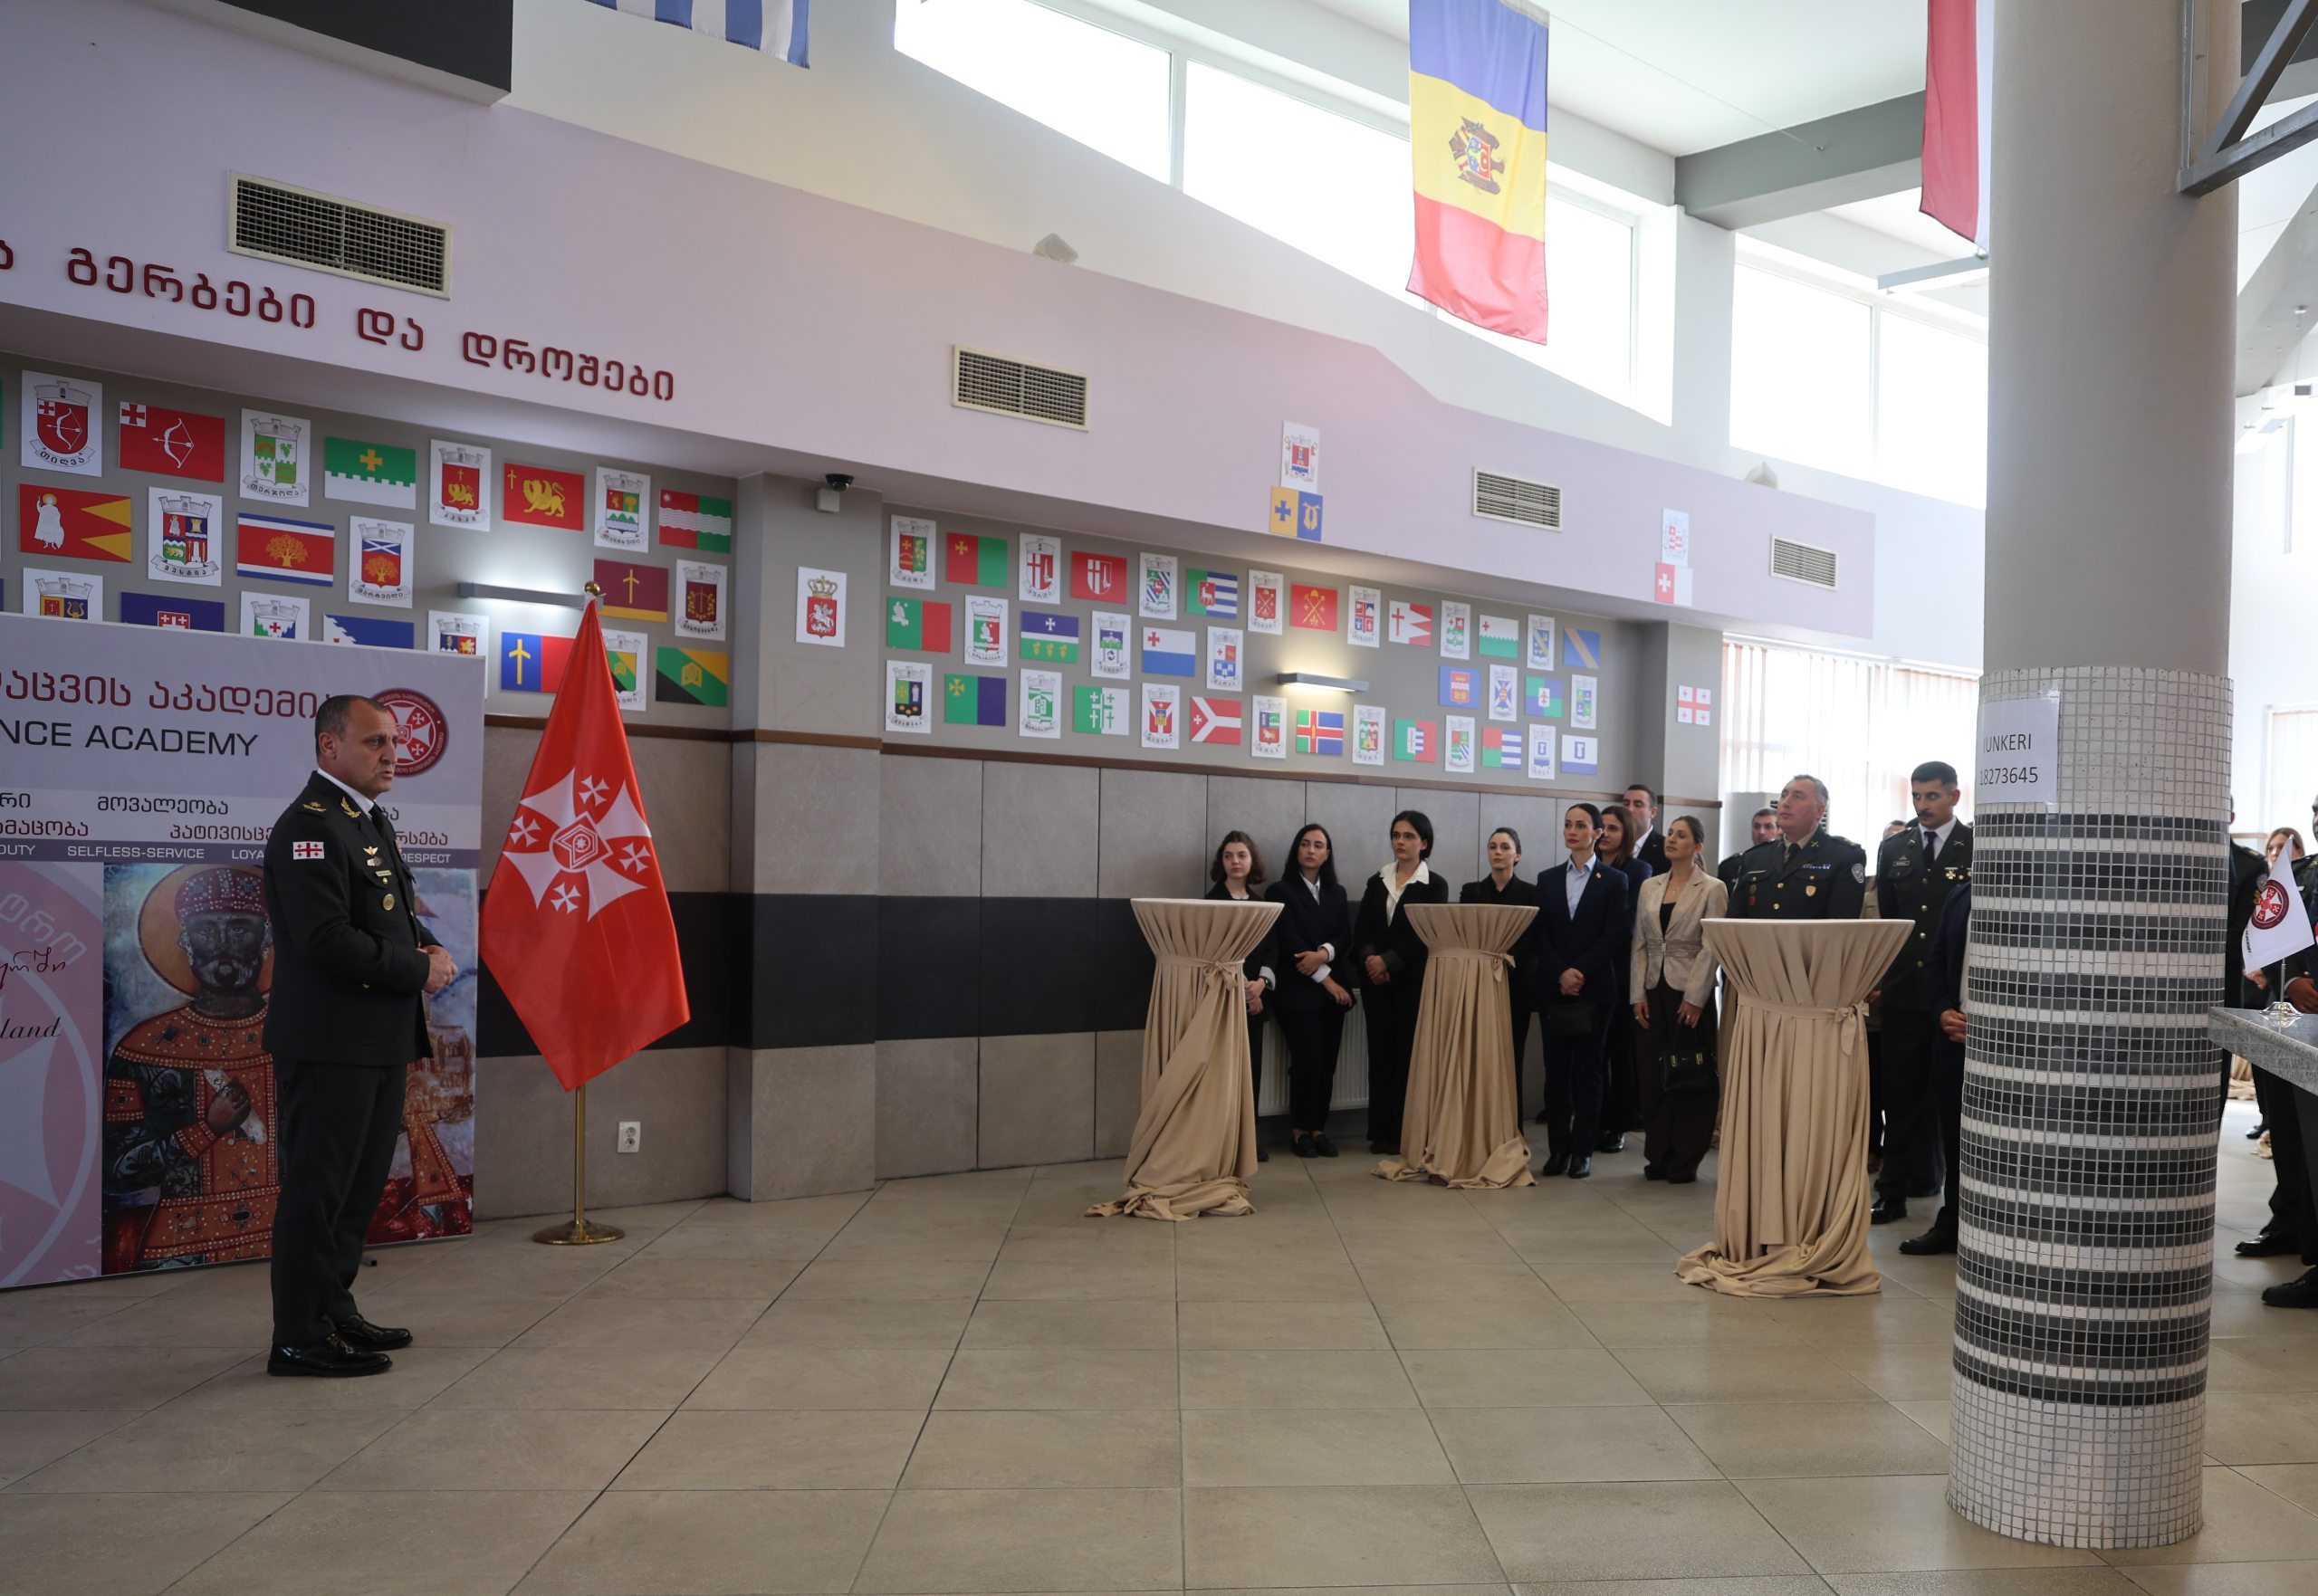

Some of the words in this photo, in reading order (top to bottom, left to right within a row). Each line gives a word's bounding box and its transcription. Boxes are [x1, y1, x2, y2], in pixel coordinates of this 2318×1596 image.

[67, 247, 315, 329] გერბები
[357, 308, 424, 352] და
[462, 331, 675, 401] დროშები
[40, 451, 85, 466] თიღვა
[251, 483, 299, 496] თერჯოლა
[164, 565, 206, 576] მესტია
[148, 681, 330, 719] აკადემი
[85, 724, 259, 757] ACADEMY
[1979, 767, 2038, 786] 18273645
[97, 796, 229, 816] მოვალეობა
[0, 819, 89, 836] მაცობა
[67, 846, 206, 860] SELFLESS-SERVICE
[404, 853, 452, 864] ESPECT
